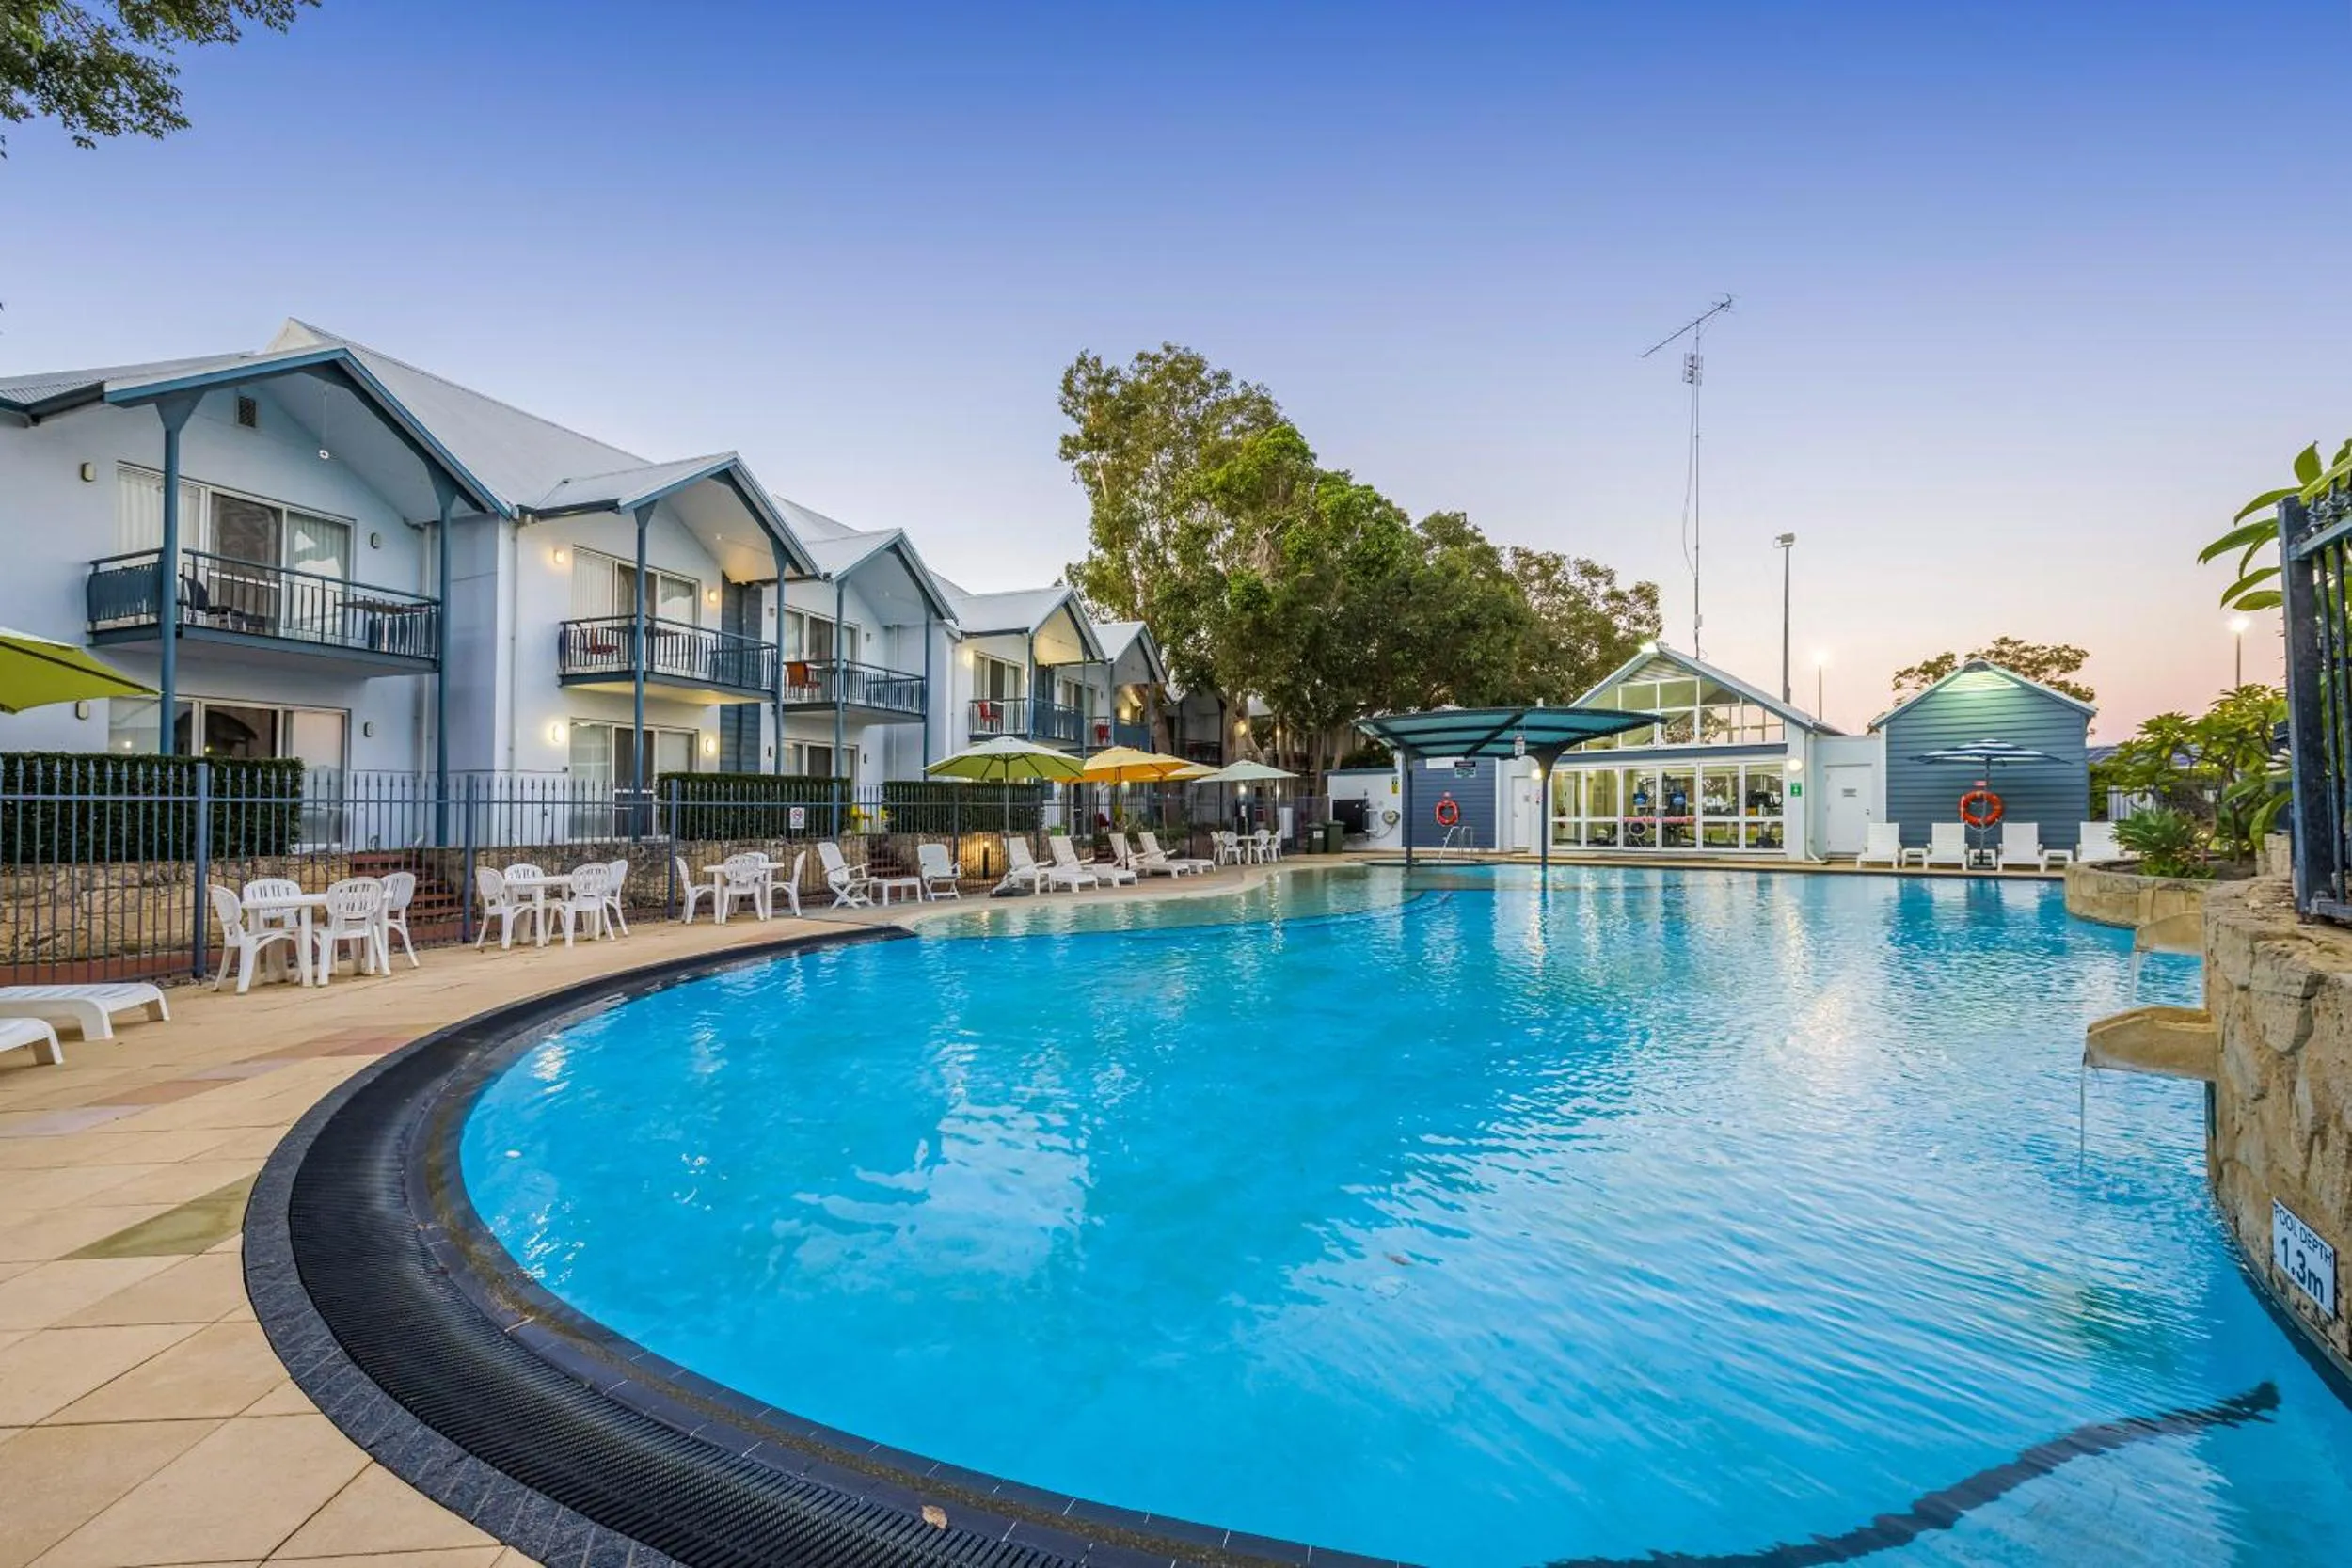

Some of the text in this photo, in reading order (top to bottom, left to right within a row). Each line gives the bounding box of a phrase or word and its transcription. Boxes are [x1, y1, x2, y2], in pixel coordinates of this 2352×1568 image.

[2274, 1204, 2333, 1267] POOL DEPTH
[2280, 1237, 2324, 1304] 1.3m
